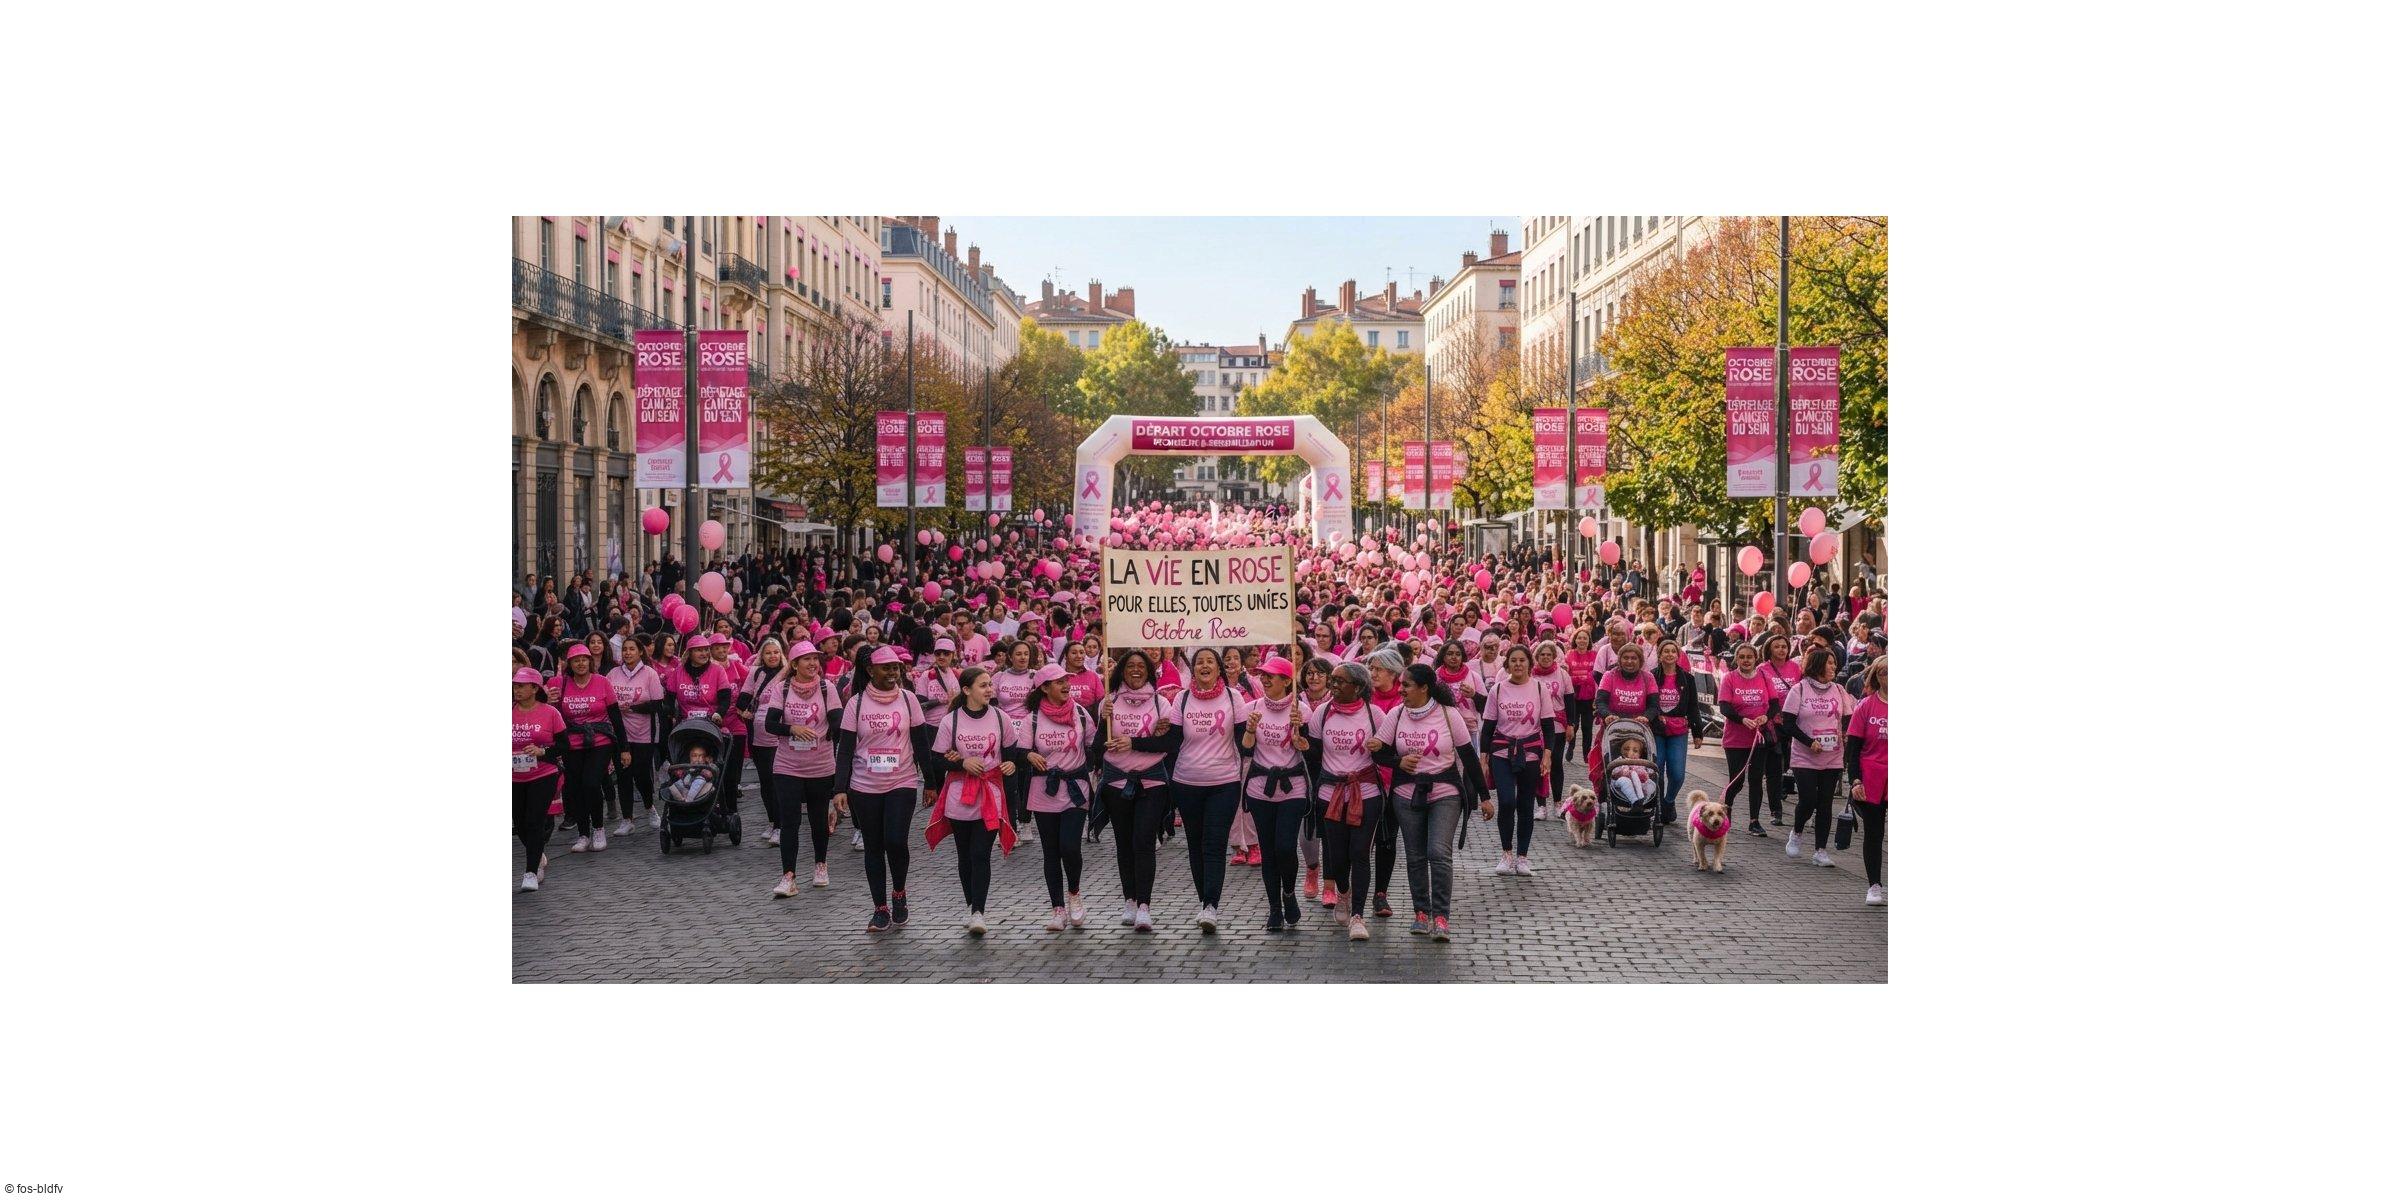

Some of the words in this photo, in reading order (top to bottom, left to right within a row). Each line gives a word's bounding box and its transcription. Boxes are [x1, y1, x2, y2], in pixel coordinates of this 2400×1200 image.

[638, 351, 682, 366] ROSE
[701, 351, 745, 366] ROSE
[1729, 367, 1772, 381] ROSE
[1792, 367, 1836, 381] ROSE
[1190, 426, 1252, 437] OCTOBRE
[1255, 425, 1290, 437] ROSE
[1796, 423, 1809, 435] DU
[1110, 558, 1140, 585] LA
[1192, 559, 1220, 585] EN
[1228, 555, 1285, 584] ROSE
[1108, 595, 1143, 613] POUR
[1149, 596, 1191, 616] ELLES,
[1192, 594, 1243, 613] TOUTES
[1208, 616, 1250, 640] Rose
